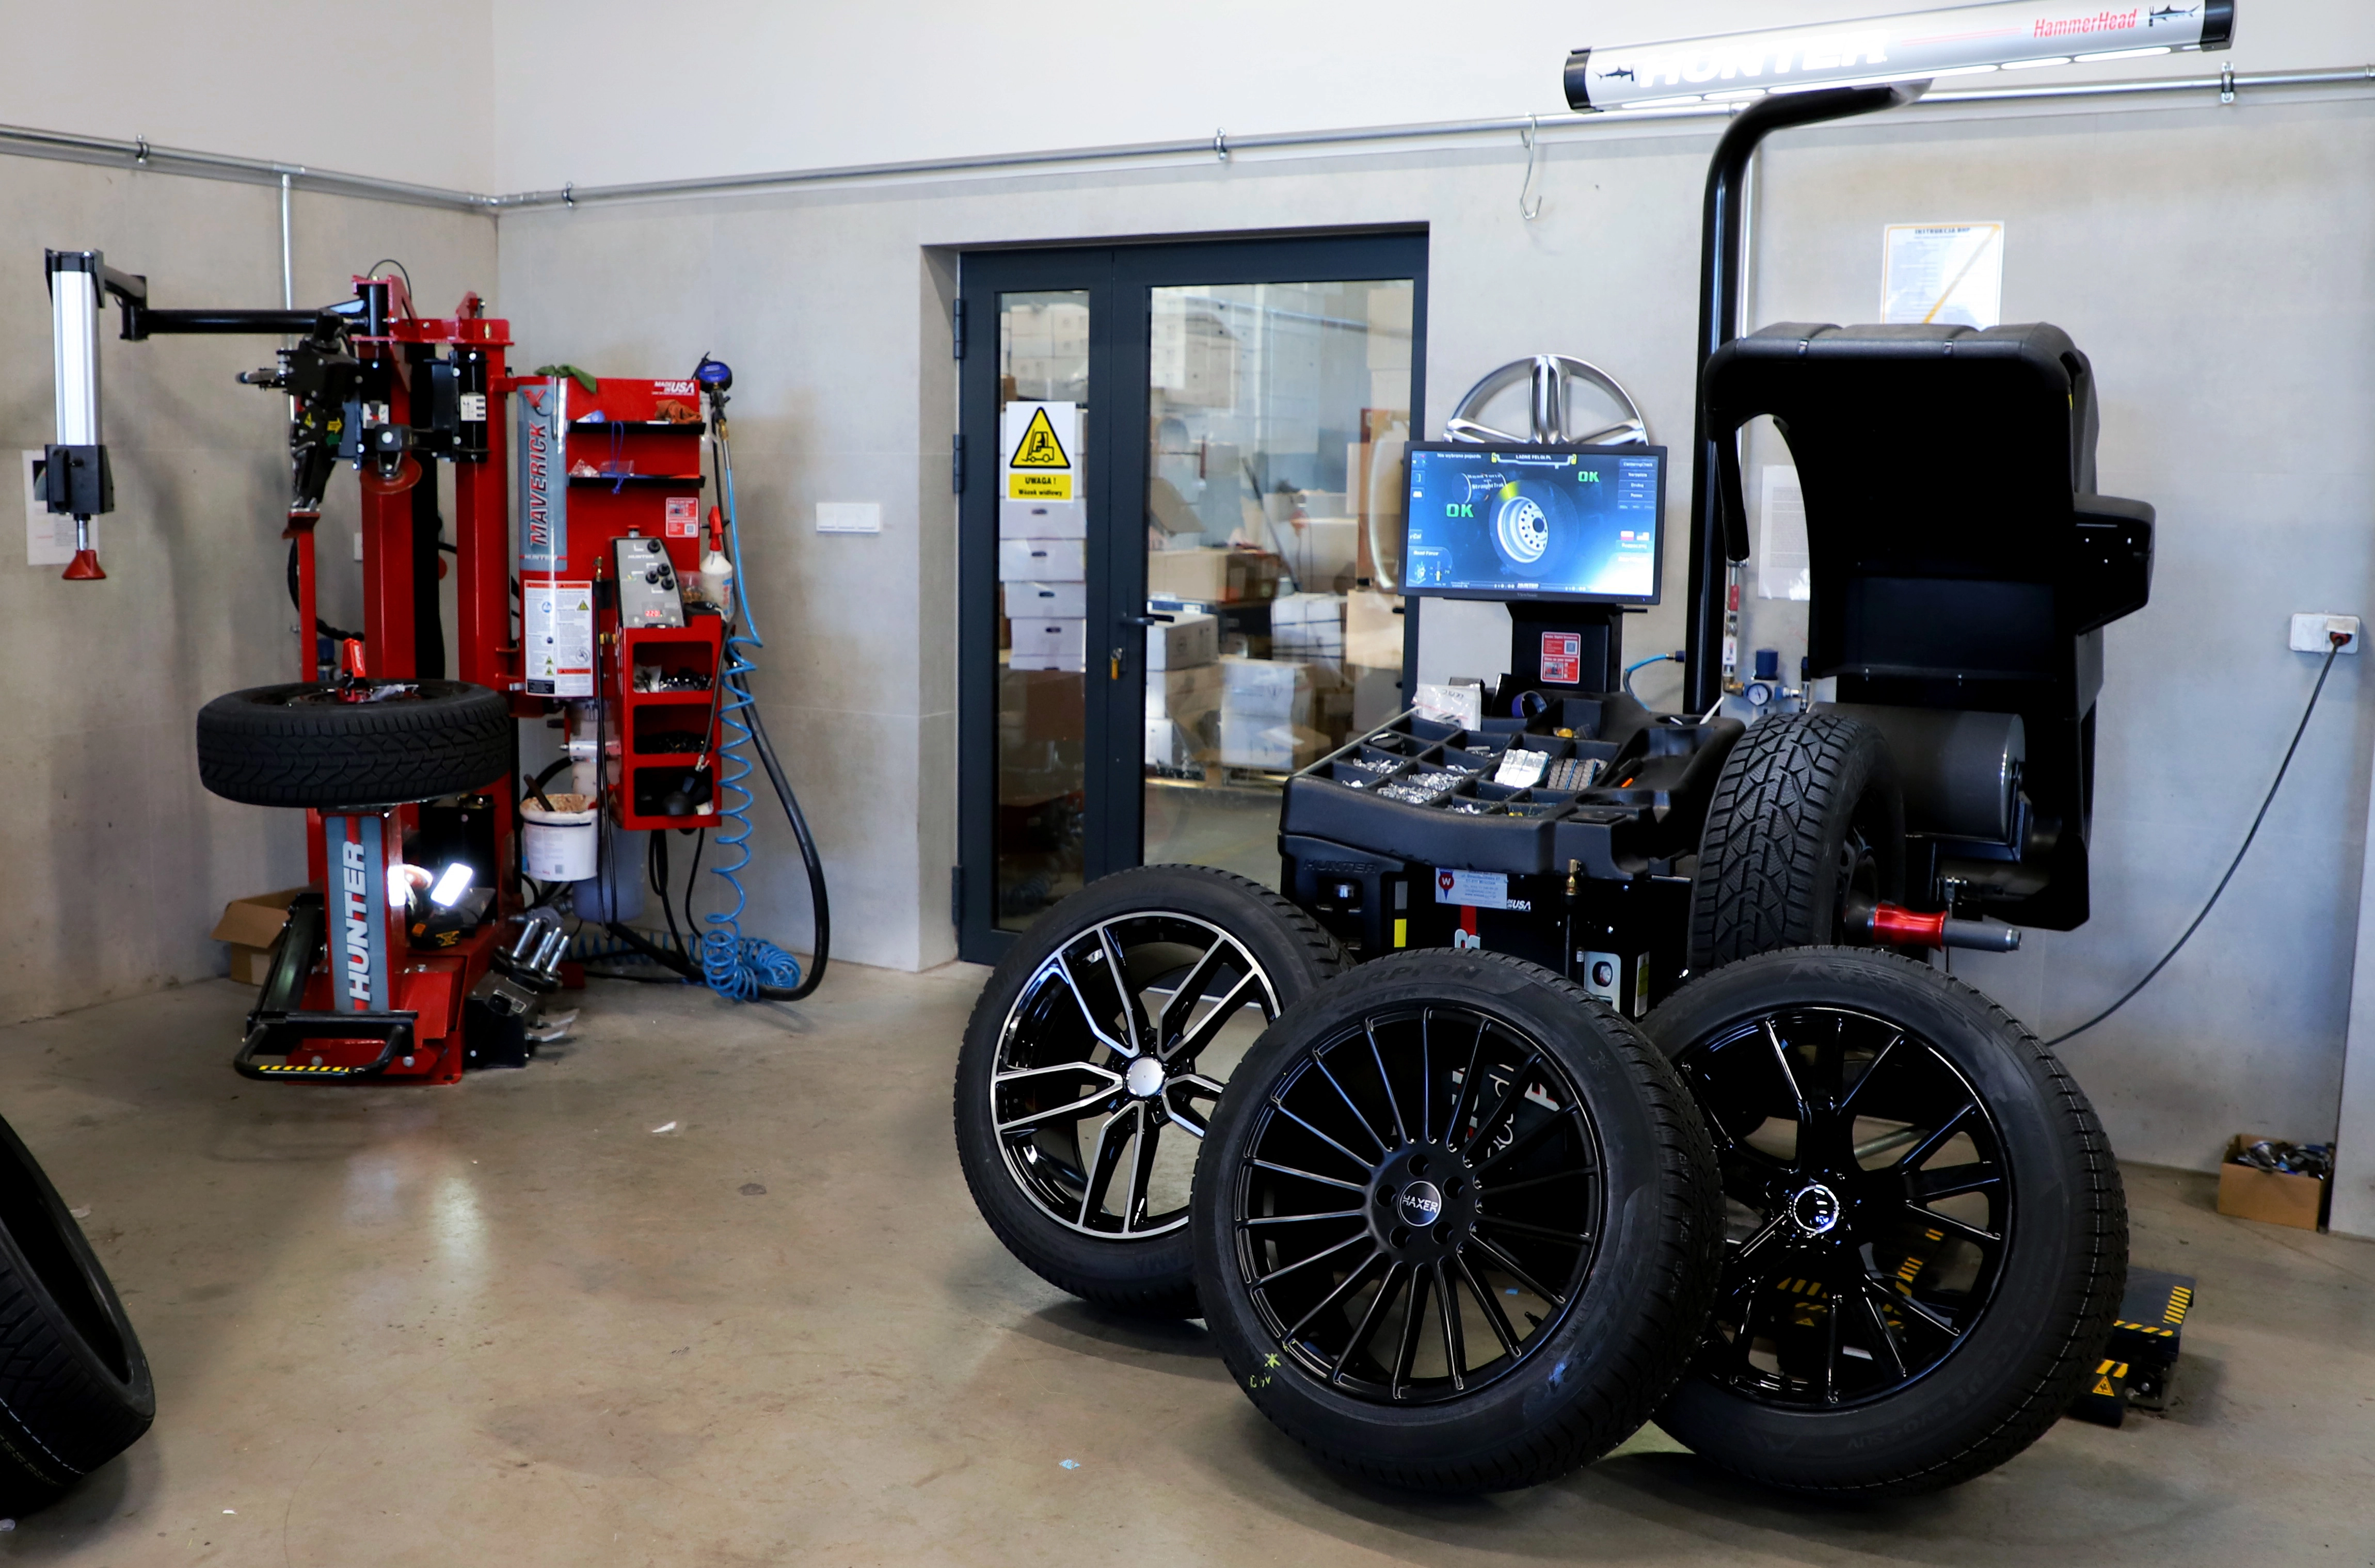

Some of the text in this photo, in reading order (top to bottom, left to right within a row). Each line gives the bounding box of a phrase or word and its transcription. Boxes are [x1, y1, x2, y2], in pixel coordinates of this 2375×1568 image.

[2034, 8, 2138, 38] HammerHead
[1638, 29, 1890, 88] HUNTER
[671, 382, 695, 394] USA
[529, 421, 548, 547] MAVERICK
[1025, 476, 1051, 485] UWAGA
[1578, 471, 1600, 482] OK
[1446, 503, 1474, 518] OK
[1303, 859, 1376, 874] HUNTER
[1441, 876, 1452, 886] W
[1512, 899, 1531, 910] USA
[343, 841, 371, 1002] HUNTER
[1401, 1194, 1438, 1214] HAXER
